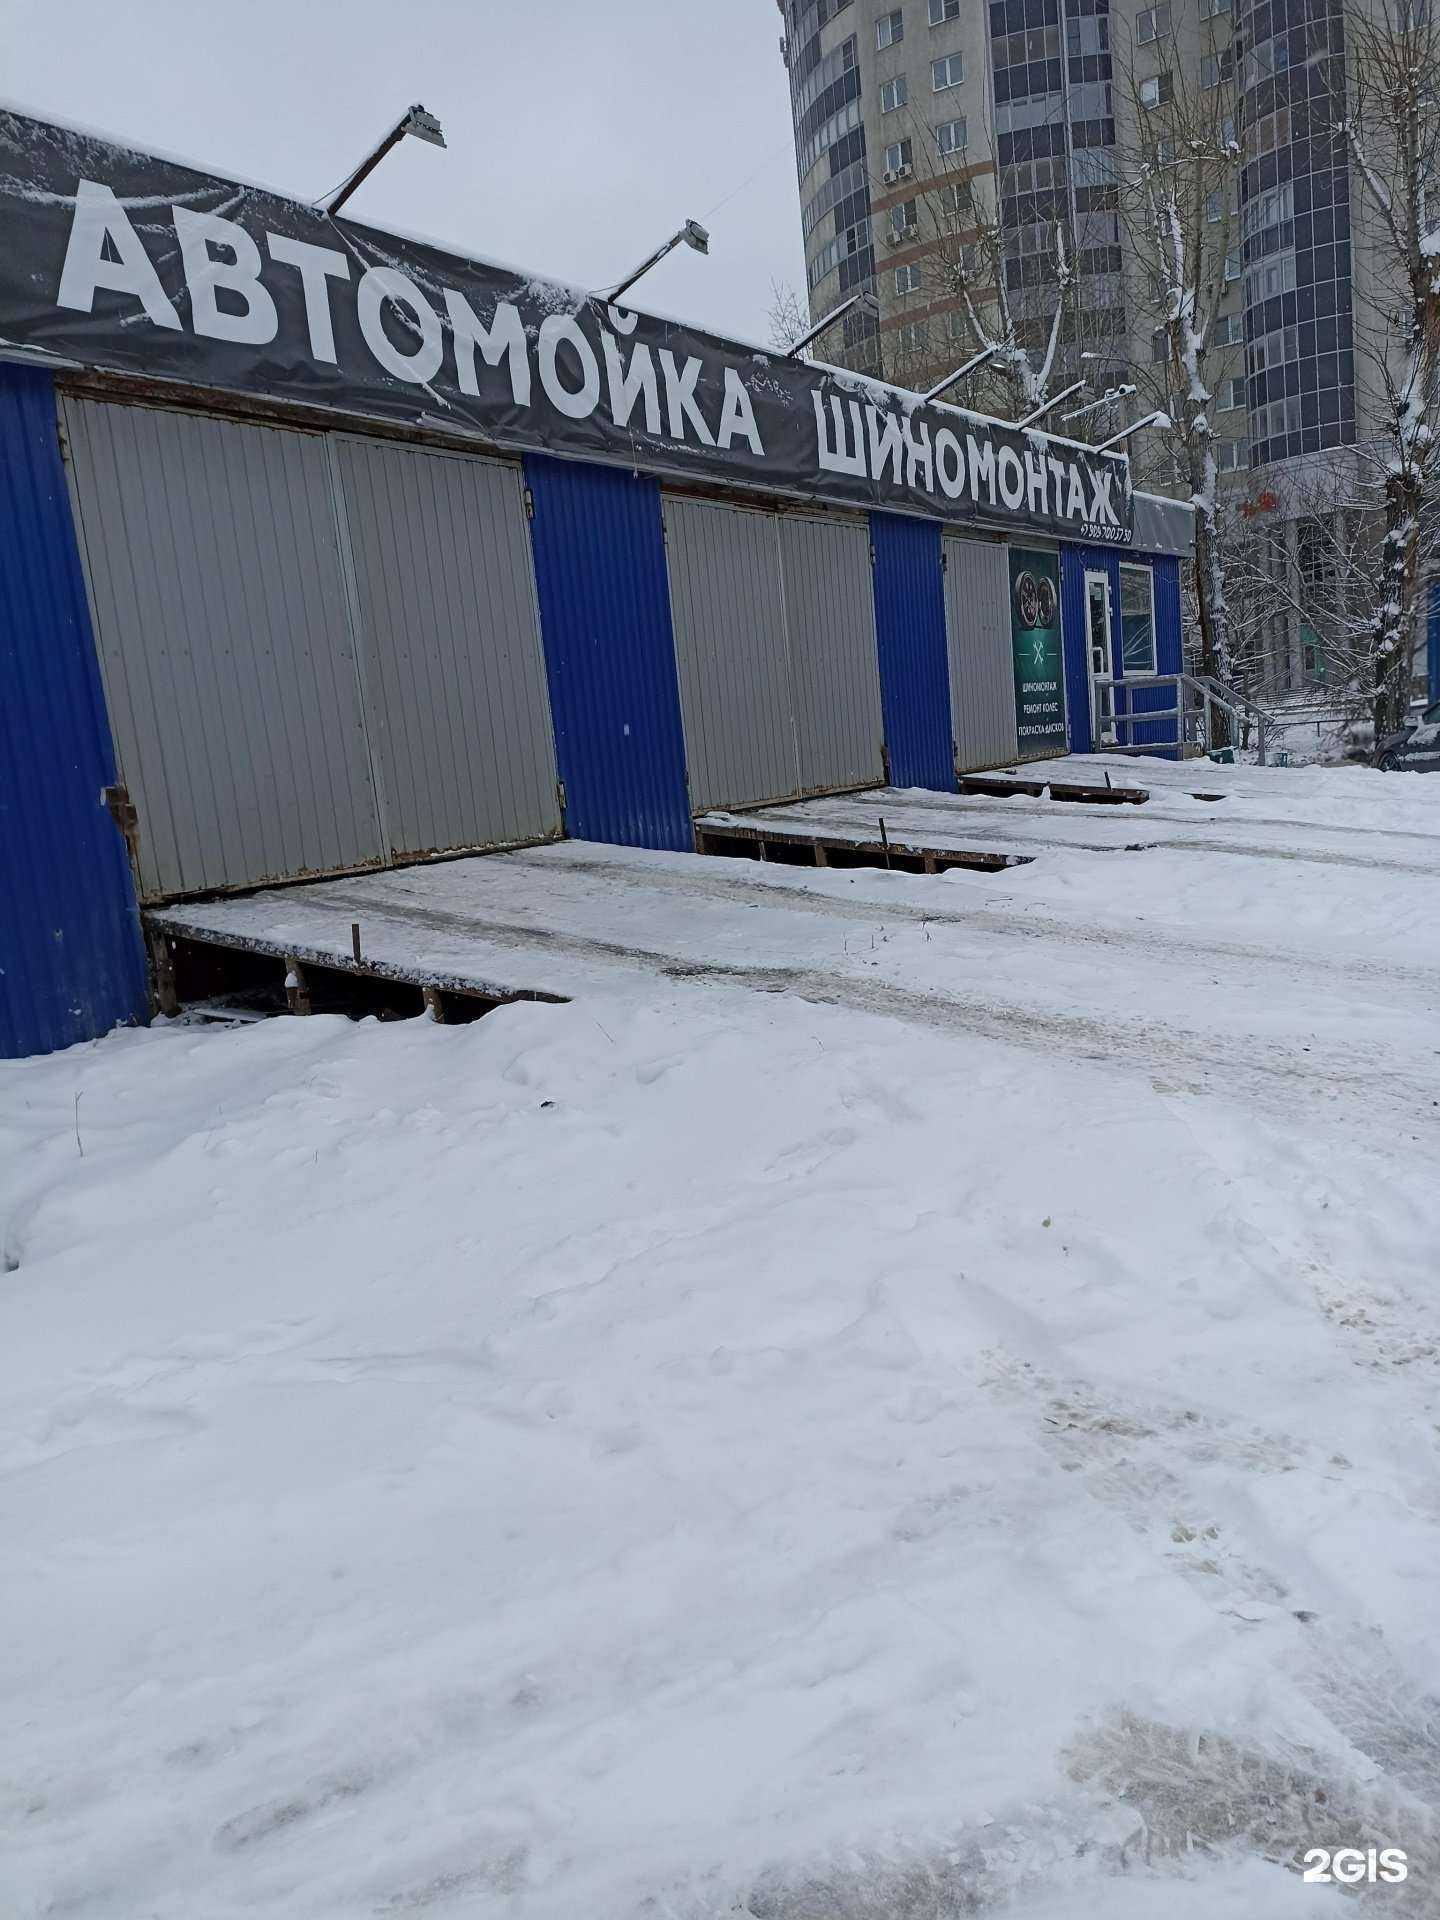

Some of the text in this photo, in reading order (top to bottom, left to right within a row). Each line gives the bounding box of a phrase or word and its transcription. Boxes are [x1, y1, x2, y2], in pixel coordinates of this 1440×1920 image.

[56, 178, 1120, 526] АВТОМОЙКА ШИНОМОНТАЖ
[1022, 681, 1057, 692] ШИНОМОНТАЖ
[1023, 702, 1059, 714] РЕМОНТ КОЛЕС
[1018, 724, 1044, 736] ПОКРАСКА
